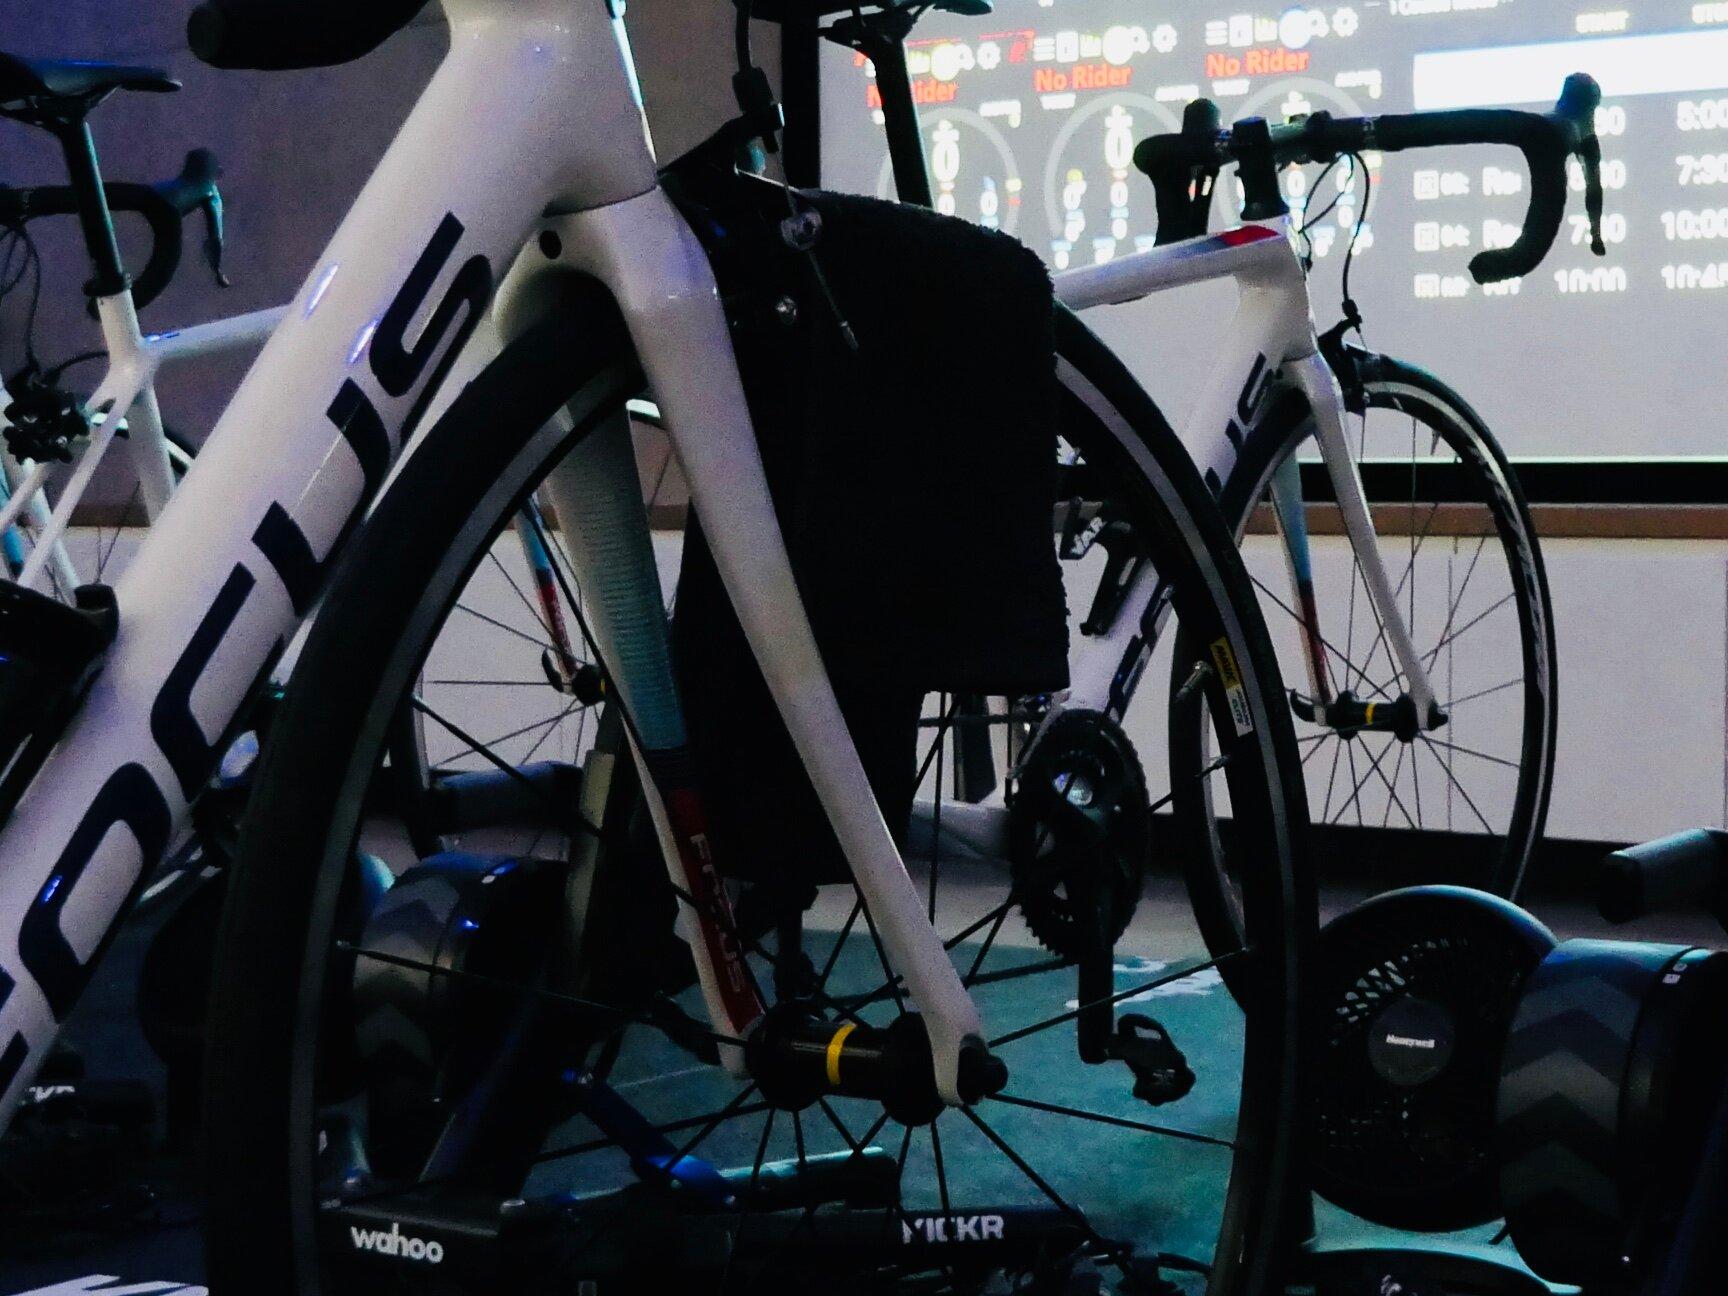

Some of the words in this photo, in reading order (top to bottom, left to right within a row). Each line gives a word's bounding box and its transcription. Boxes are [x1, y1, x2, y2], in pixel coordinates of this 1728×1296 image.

[1033, 69, 1068, 93] No
[1072, 62, 1133, 91] Rider
[1205, 53, 1240, 79] No
[1244, 49, 1311, 75] Rider
[914, 79, 959, 104] ider
[1568, 213, 1627, 247] 7:0
[350, 1222, 445, 1265] wahoo
